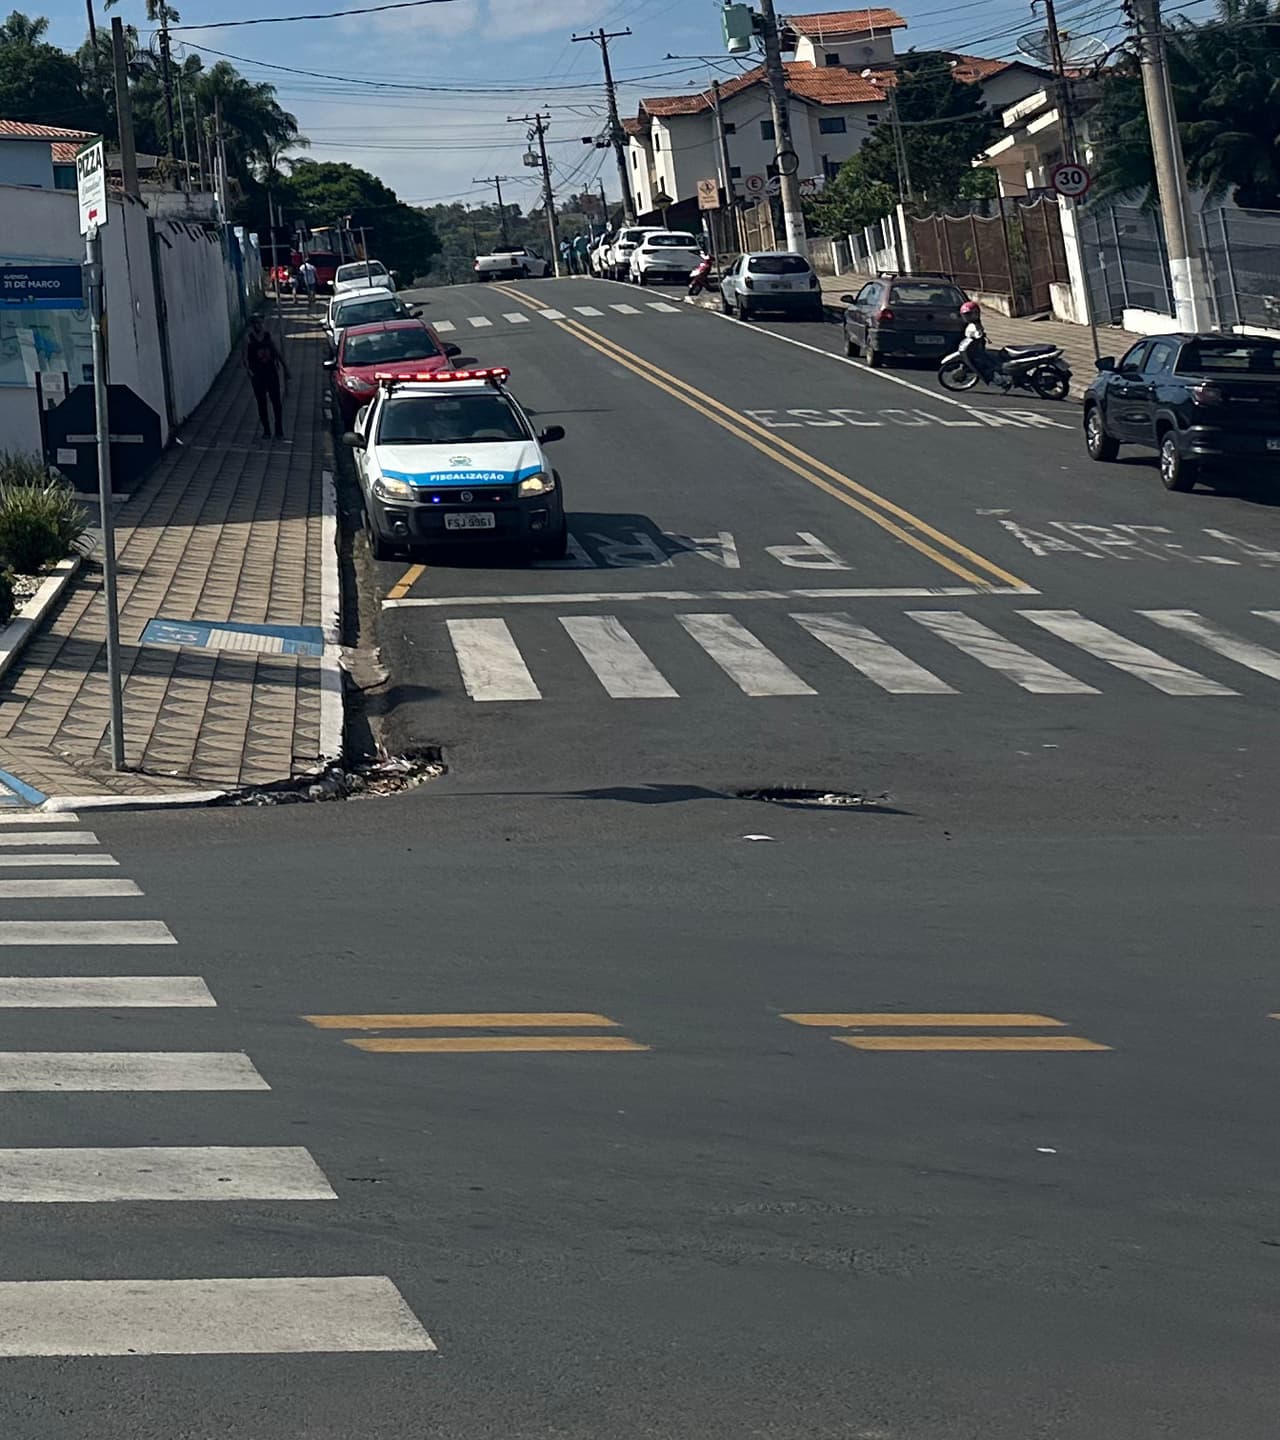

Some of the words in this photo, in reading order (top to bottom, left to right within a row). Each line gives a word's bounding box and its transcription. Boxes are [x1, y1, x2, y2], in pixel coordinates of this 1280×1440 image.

[77, 146, 103, 182] PIZZA
[1059, 170, 1082, 185] 30
[14, 280, 27, 289] DE
[743, 407, 1076, 430] ESCOLAR
[429, 472, 505, 482] FISCALIZAÇÃO
